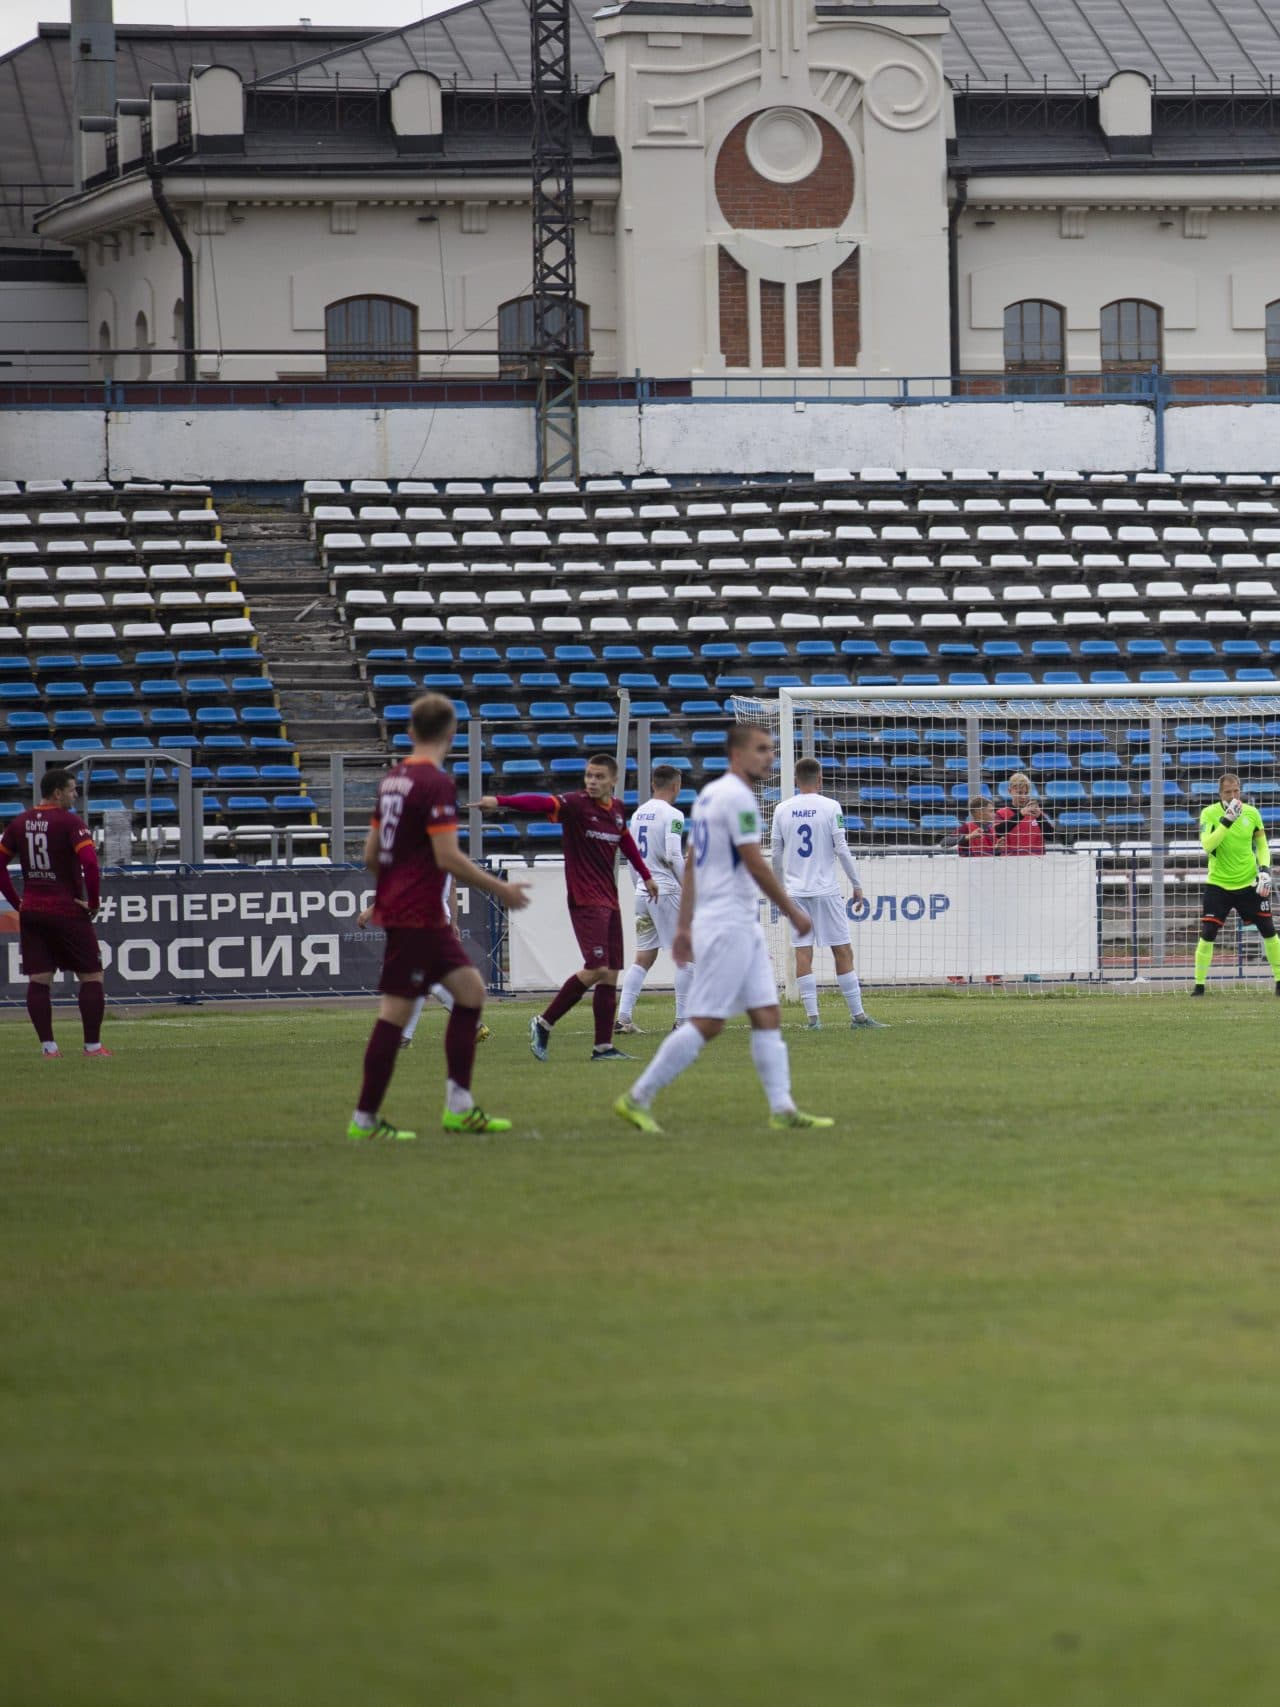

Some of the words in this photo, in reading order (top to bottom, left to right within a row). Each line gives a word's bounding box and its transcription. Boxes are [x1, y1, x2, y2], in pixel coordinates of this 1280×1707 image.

[25, 832, 51, 870] 13
[638, 825, 648, 859] 5
[797, 824, 812, 858] 3
